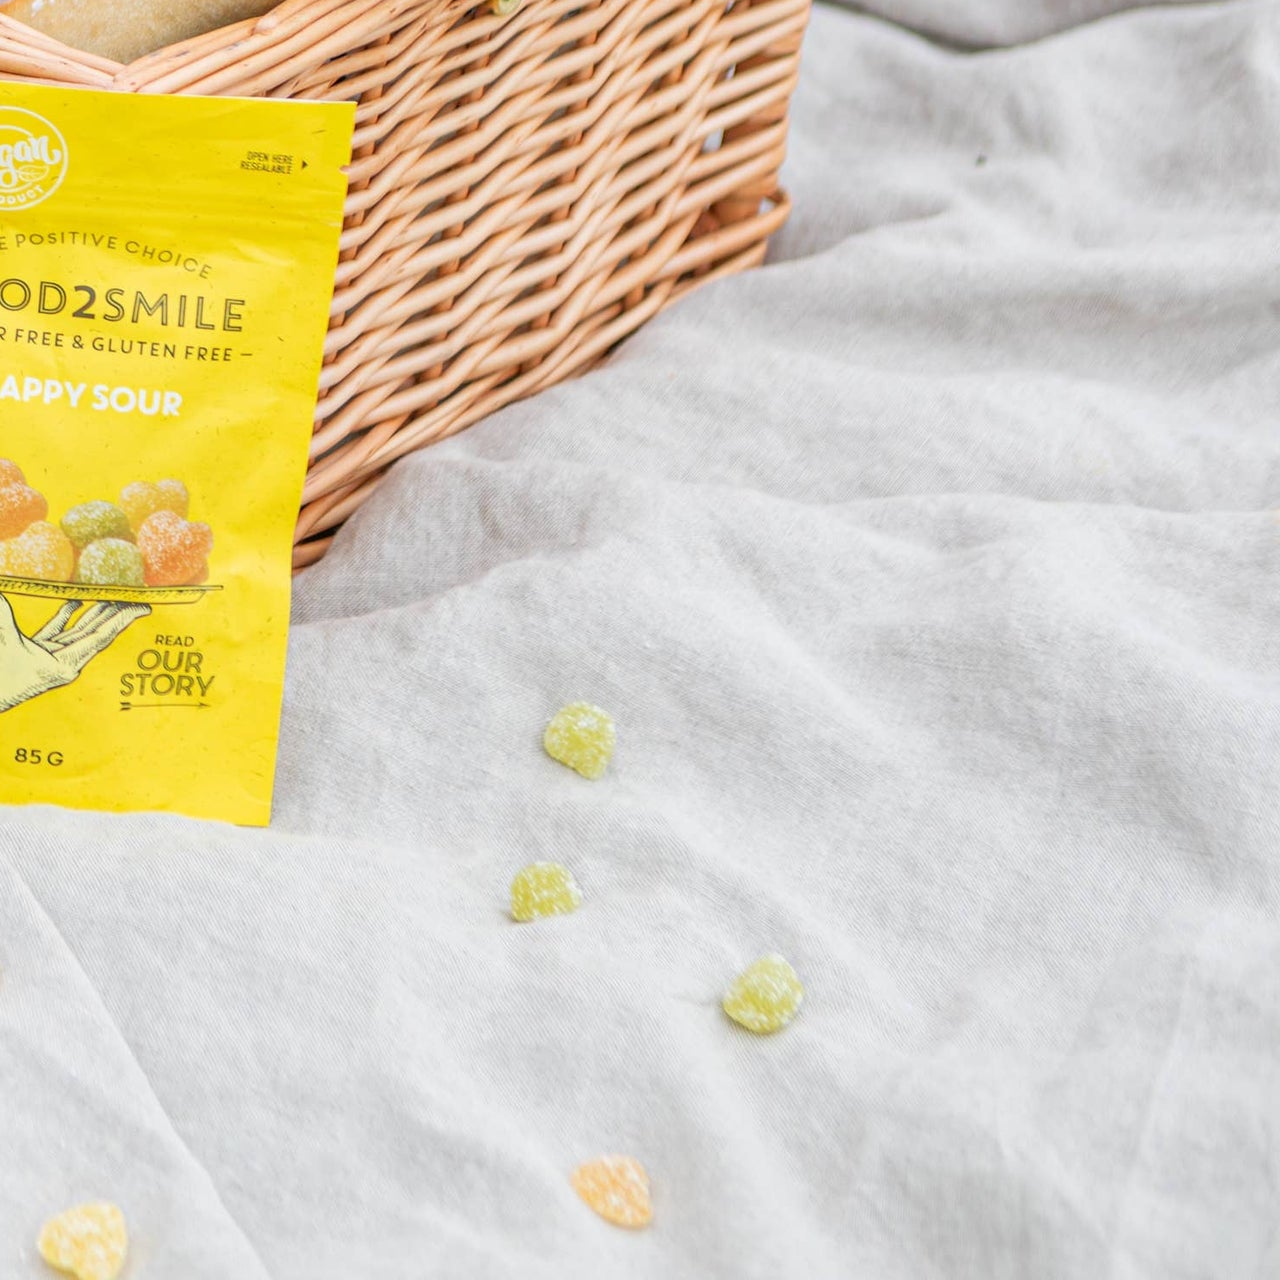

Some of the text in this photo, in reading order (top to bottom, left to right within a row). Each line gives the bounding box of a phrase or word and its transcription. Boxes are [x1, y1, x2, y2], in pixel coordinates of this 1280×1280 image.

[240, 160, 291, 174] RESEALABLE
[246, 151, 293, 165] OPEN HERE
[15, 231, 118, 250] POSITIVE
[124, 239, 213, 280] CHOICE
[14, 328, 65, 348] FREE
[72, 334, 85, 350] &
[92, 336, 177, 359] GLUTEN
[184, 345, 233, 362] FREE
[92, 383, 183, 417] SOUR
[154, 634, 195, 648] READ
[136, 648, 204, 674] OUR
[119, 672, 216, 698] STORY
